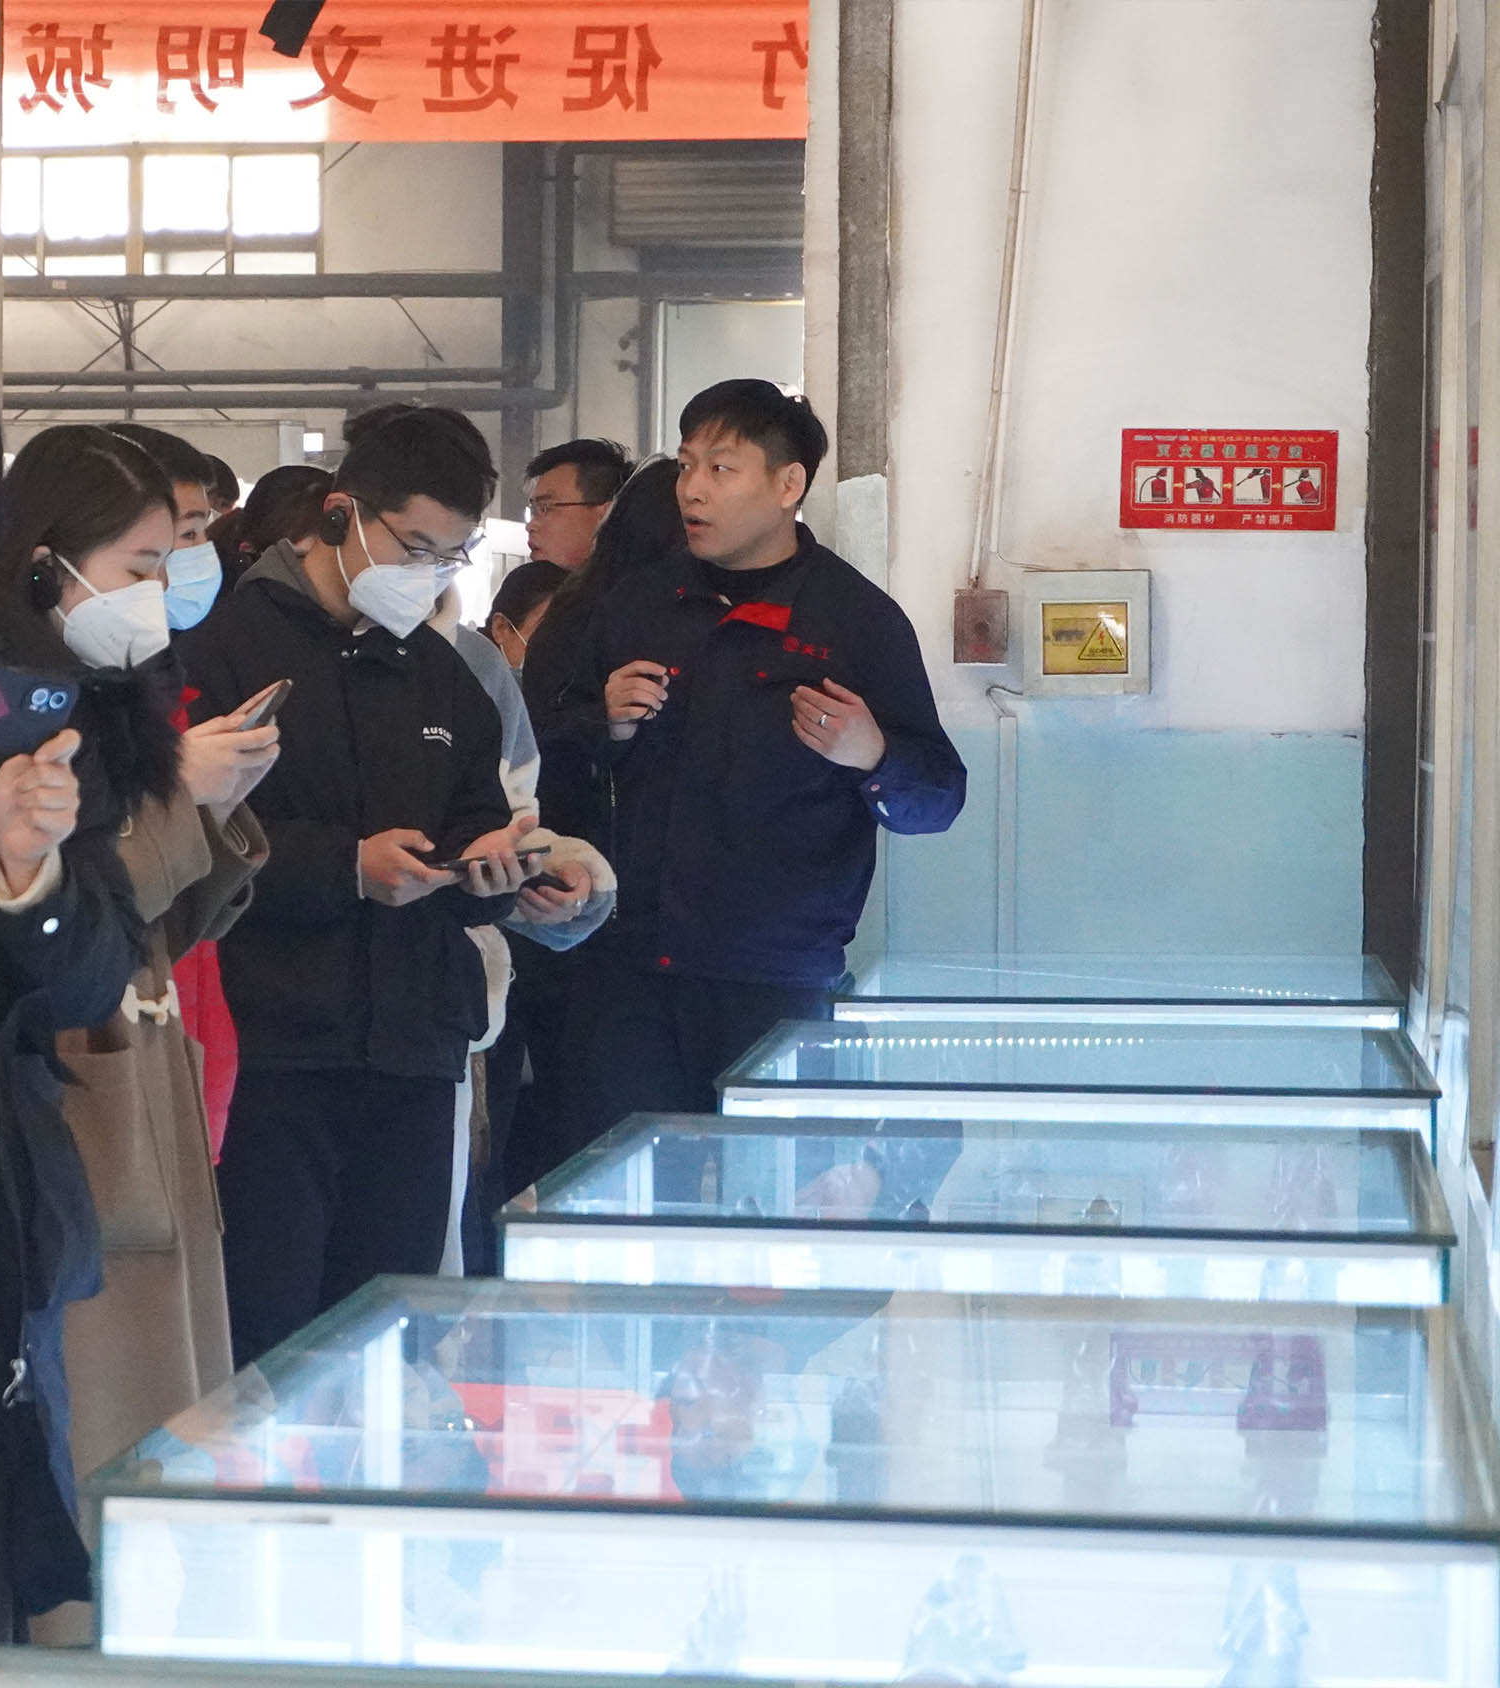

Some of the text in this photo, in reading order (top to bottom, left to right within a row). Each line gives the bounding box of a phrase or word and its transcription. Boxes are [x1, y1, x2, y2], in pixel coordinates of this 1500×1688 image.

[1163, 513, 1293, 525] 消防器材 严禁挪用
